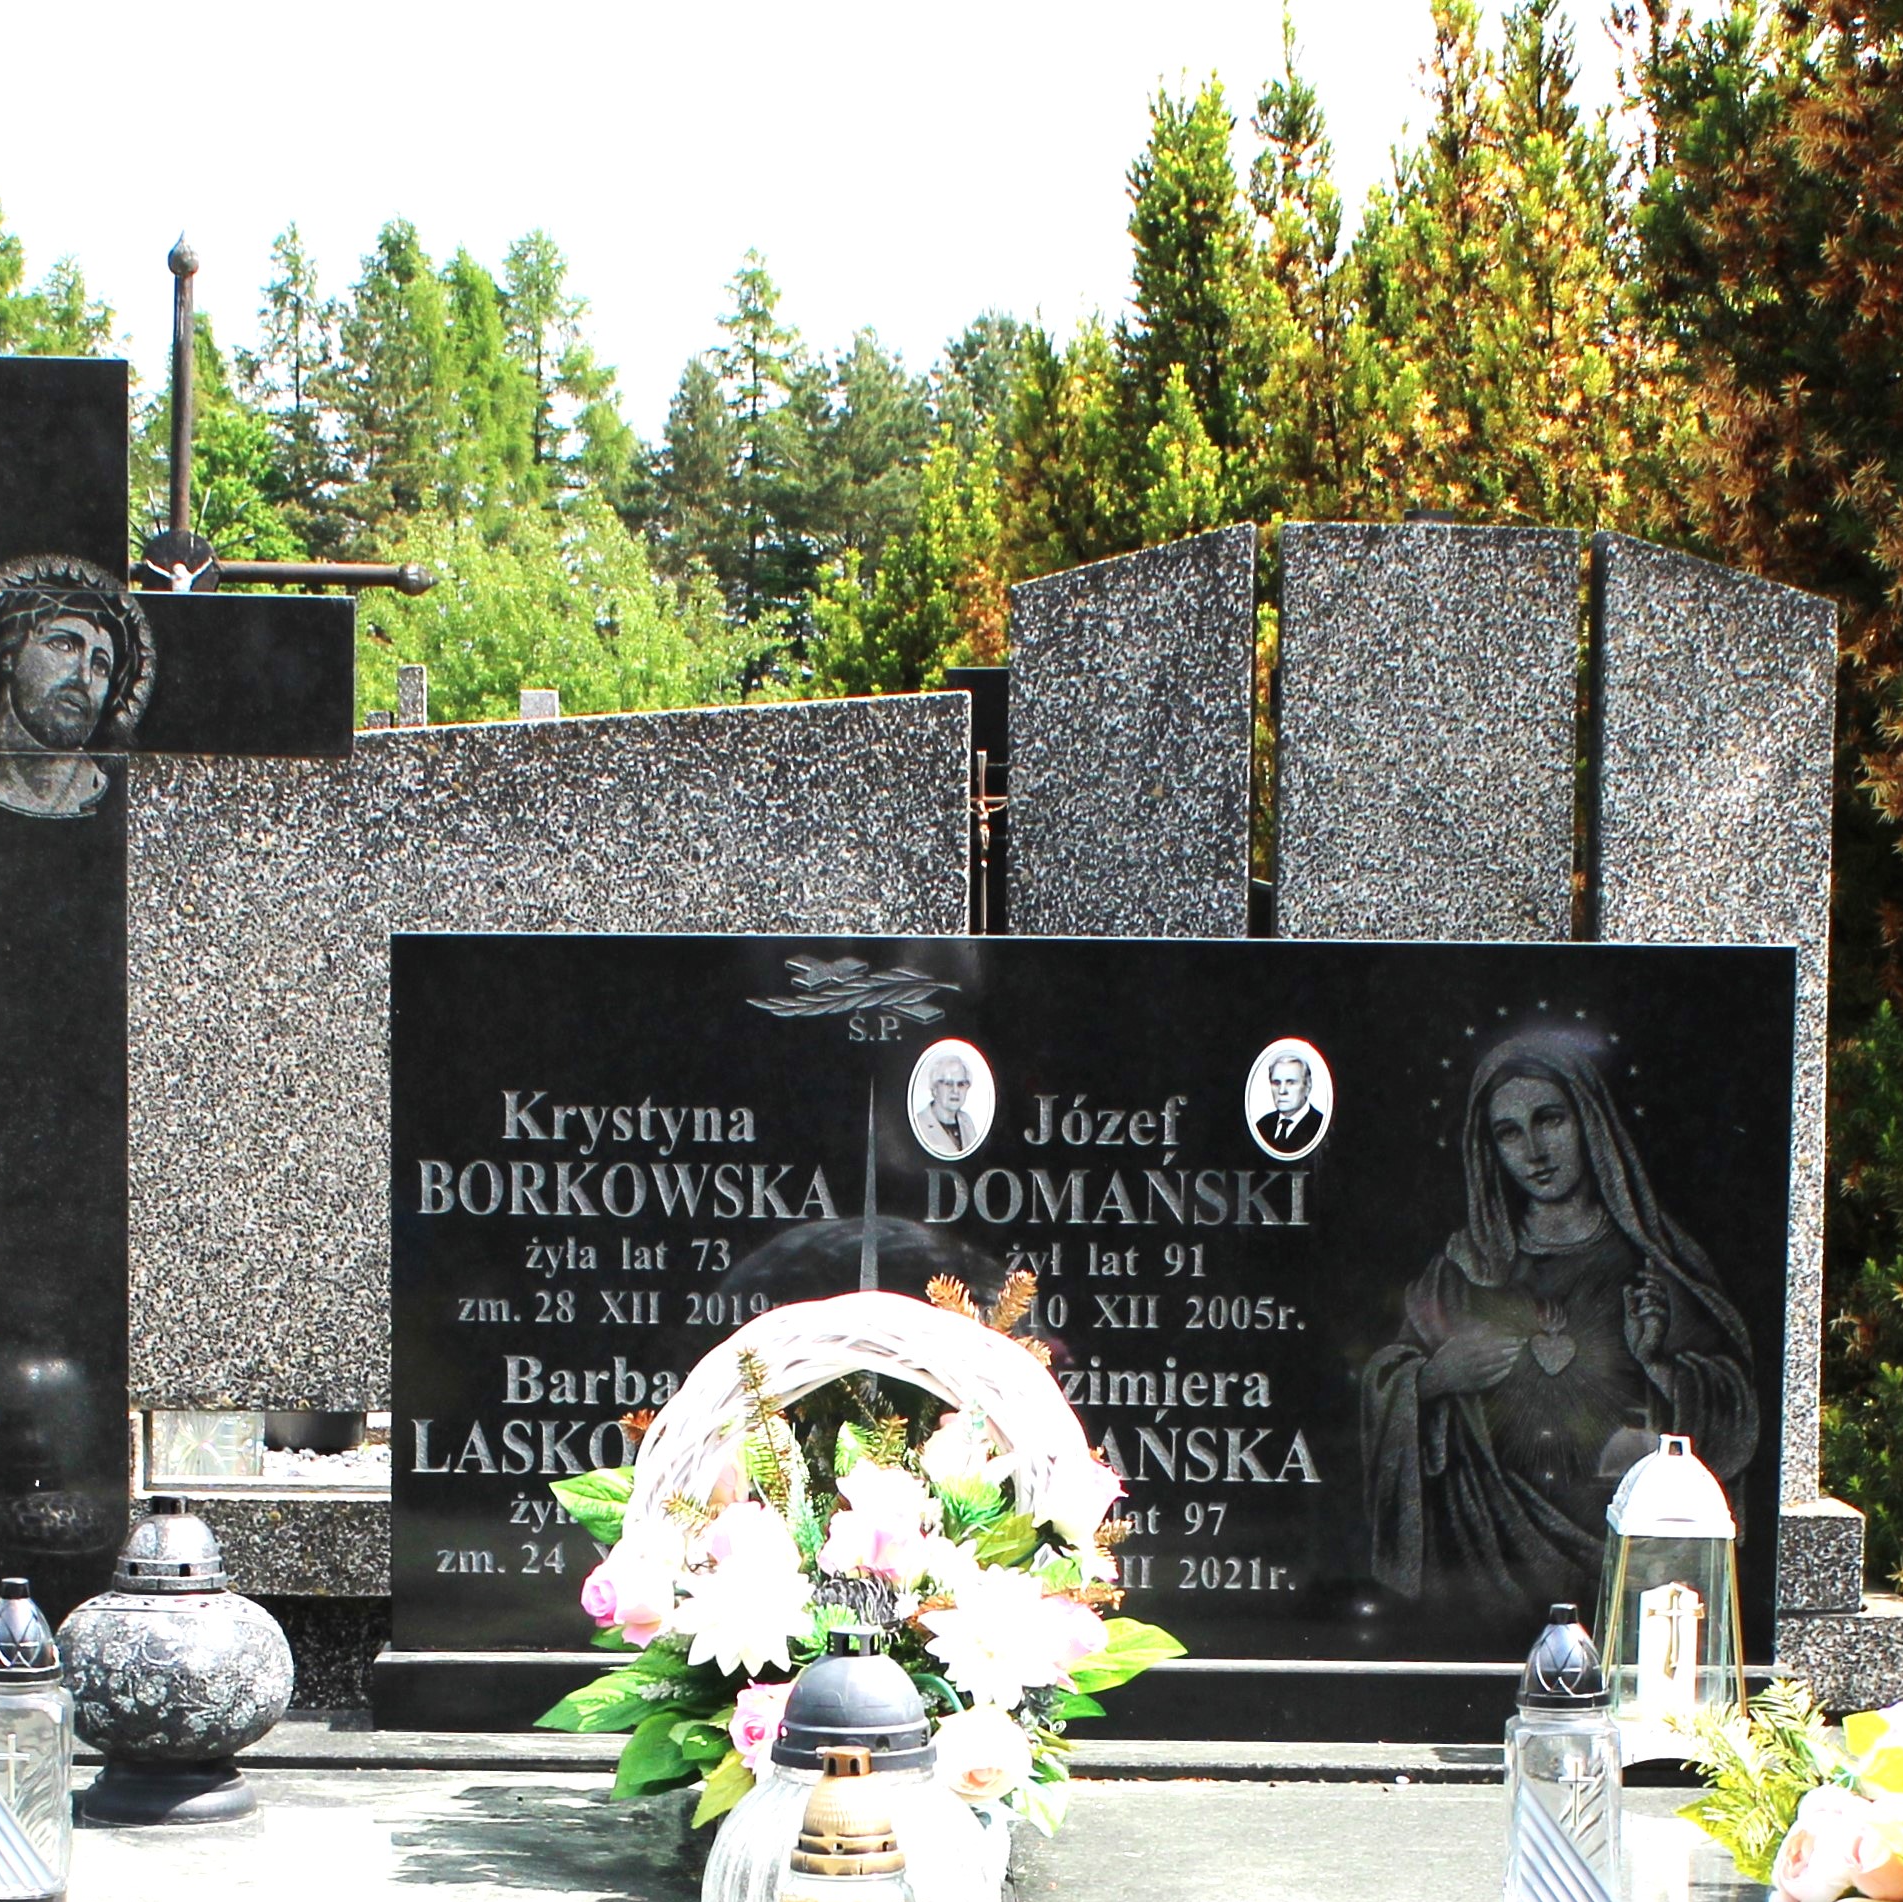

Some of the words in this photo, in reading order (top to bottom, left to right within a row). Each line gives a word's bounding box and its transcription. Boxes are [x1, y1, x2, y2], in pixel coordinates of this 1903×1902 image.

[848, 1009, 903, 1041] Ś.P.
[501, 1089, 757, 1156] Krystyna
[1024, 1093, 1188, 1146] Józef
[417, 1158, 840, 1220] BORKOWSKA
[924, 1151, 1310, 1226] DOMAŃSKI
[525, 1236, 598, 1279] żyła
[621, 1237, 668, 1272] lat
[692, 1238, 732, 1272] 73
[1006, 1243, 1063, 1277] żył
[1088, 1243, 1139, 1277] lat
[1164, 1243, 1207, 1278] 91
[458, 1295, 522, 1323] zm.
[535, 1290, 576, 1324] 28
[599, 1291, 660, 1325] XII
[685, 1291, 780, 1326] 2019
[1027, 1294, 1069, 1329] 10
[1093, 1294, 1160, 1329] XII
[1185, 1294, 1306, 1331] 2005r.
[501, 1354, 682, 1405] Barba
[1058, 1355, 1272, 1408] zimiera
[411, 1418, 636, 1475] LASKO
[1097, 1409, 1322, 1483] AŃSKA
[1184, 1501, 1228, 1536] 97
[436, 1548, 506, 1574] zm.
[520, 1540, 566, 1575] 24
[1178, 1556, 1297, 1591] 2021r.
